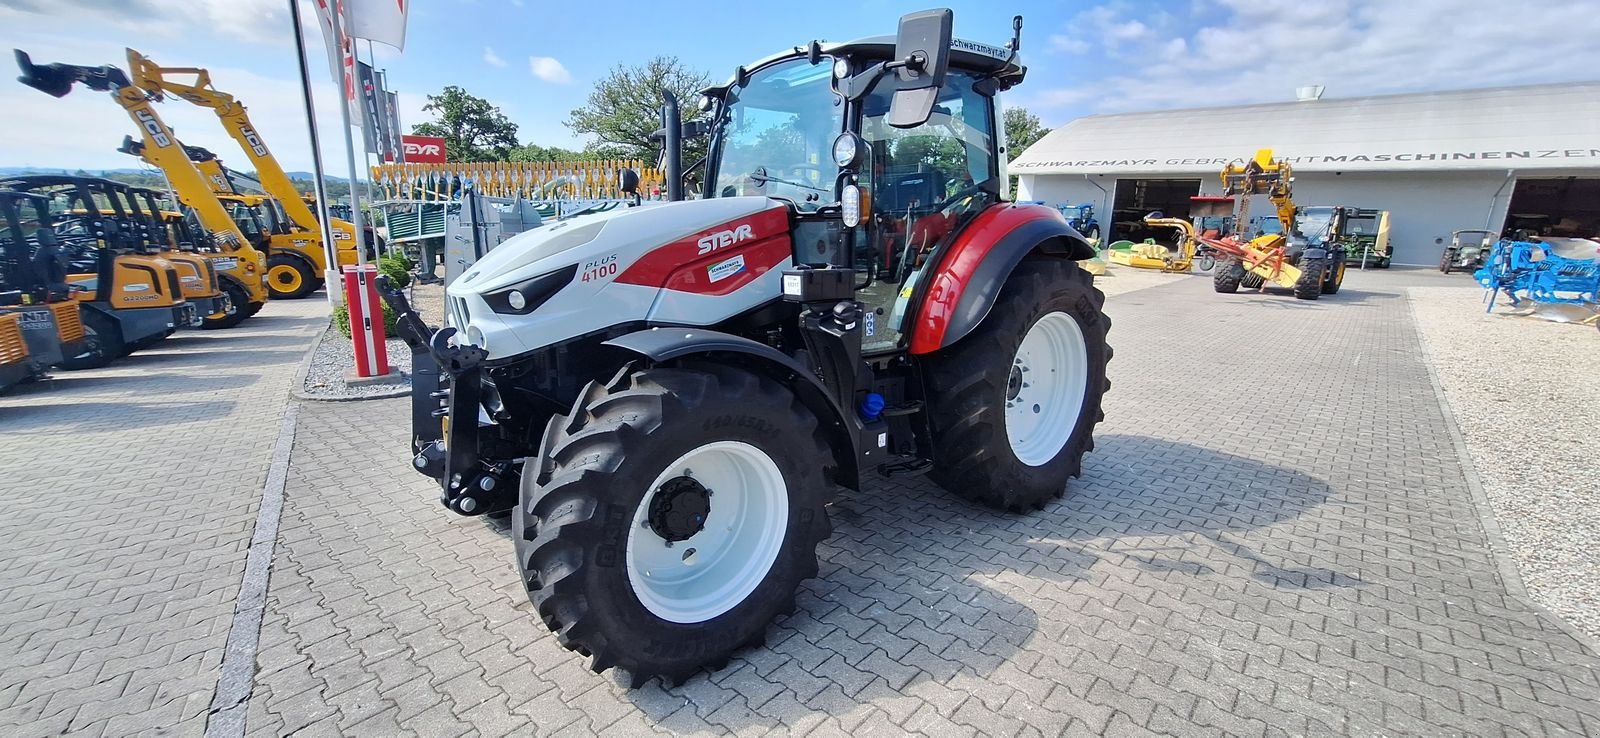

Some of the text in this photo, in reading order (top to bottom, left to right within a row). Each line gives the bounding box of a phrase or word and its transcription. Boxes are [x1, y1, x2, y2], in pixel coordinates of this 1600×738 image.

[135, 109, 171, 148] JCB
[240, 126, 267, 157] JCB
[403, 143, 440, 156] EYR
[1014, 158, 1158, 169] SCHWARZMAYR
[332, 232, 351, 241] CB
[698, 224, 753, 255] STEYR
[585, 253, 617, 270] PLUS
[582, 262, 617, 283] 4100
